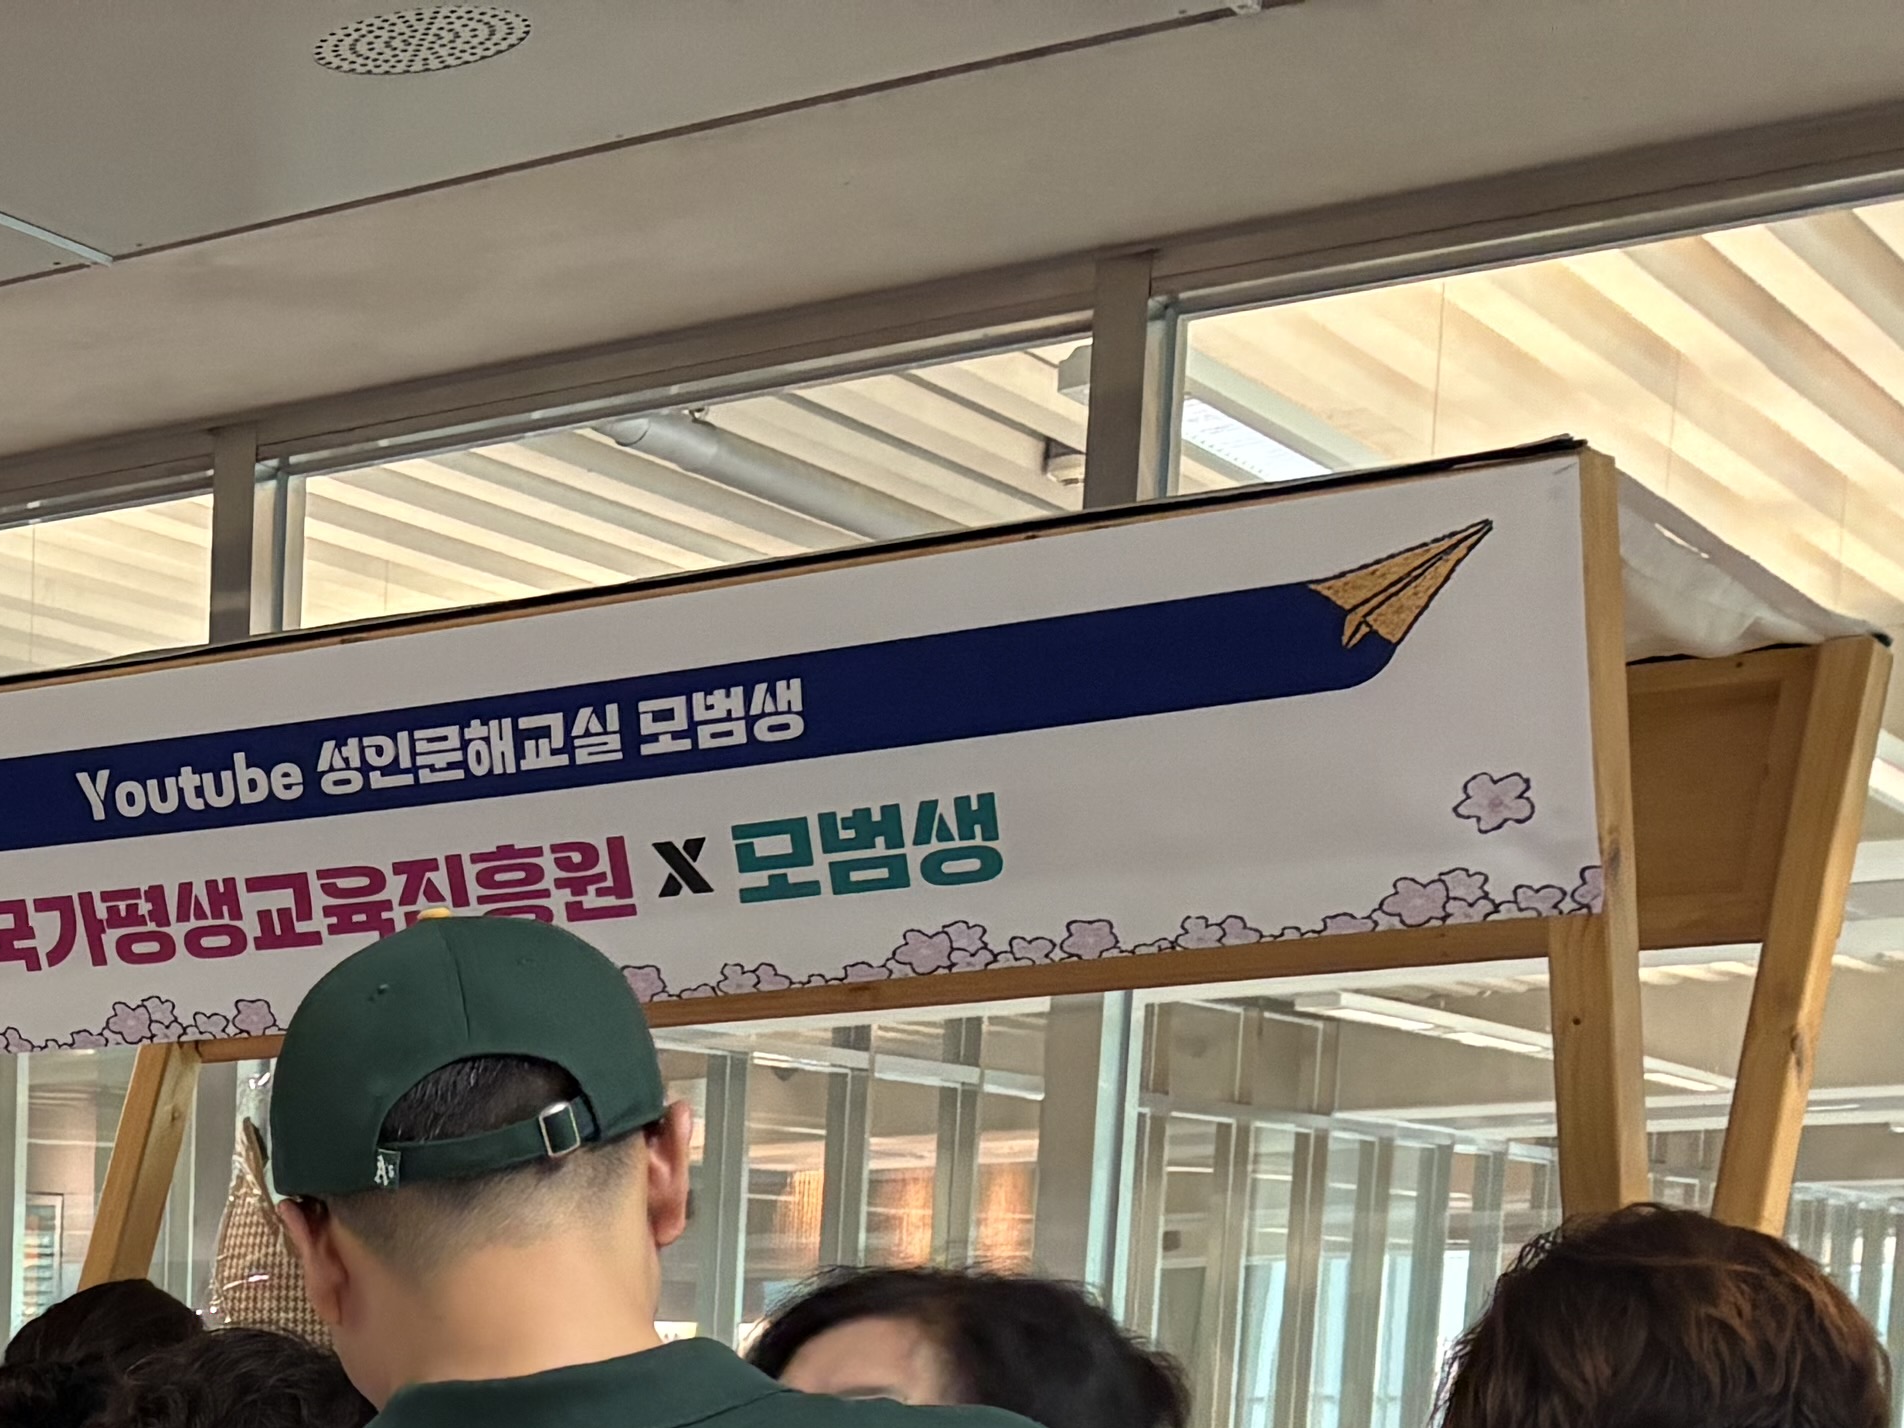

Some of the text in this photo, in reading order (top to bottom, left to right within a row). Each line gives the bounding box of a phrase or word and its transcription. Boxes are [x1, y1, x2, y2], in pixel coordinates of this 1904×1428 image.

[75, 677, 806, 822] Youtube 성인문해교실 모범생
[730, 791, 1004, 905] 모범생
